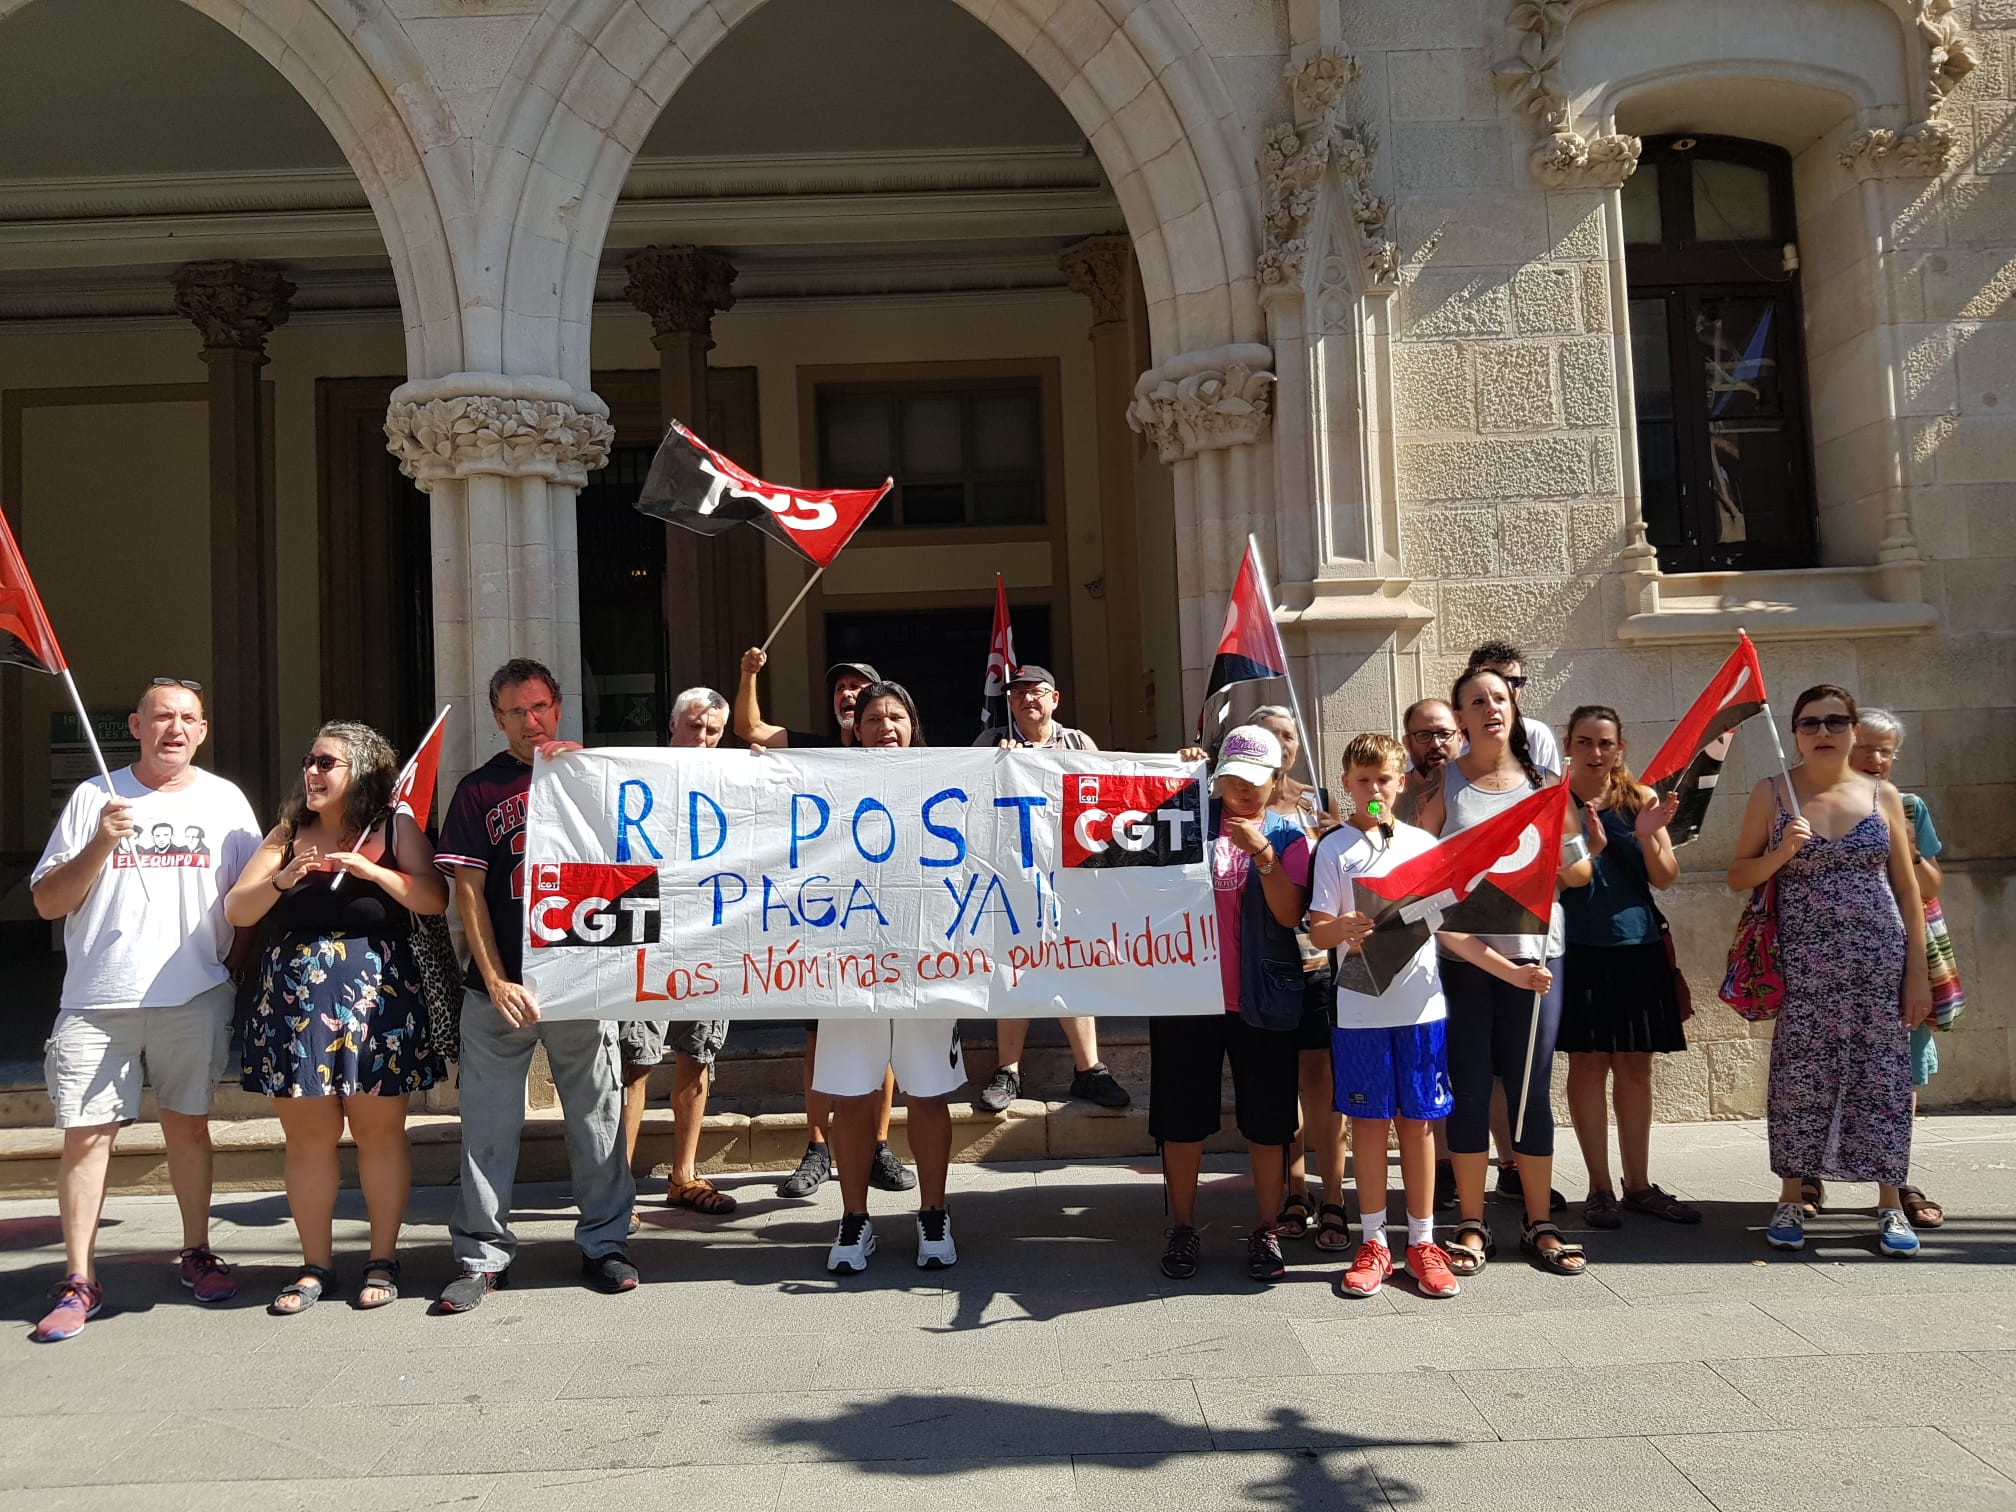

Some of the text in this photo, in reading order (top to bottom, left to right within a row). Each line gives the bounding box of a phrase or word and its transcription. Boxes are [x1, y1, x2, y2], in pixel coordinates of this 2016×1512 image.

[616, 779, 1047, 869] RD POST
[1074, 808, 1194, 853] CGT
[117, 854, 206, 867] EL EQUIPO A
[531, 896, 660, 943] CGT
[698, 872, 889, 931] PAGA
[742, 939, 903, 995] Nóminas
[917, 947, 992, 980] con
